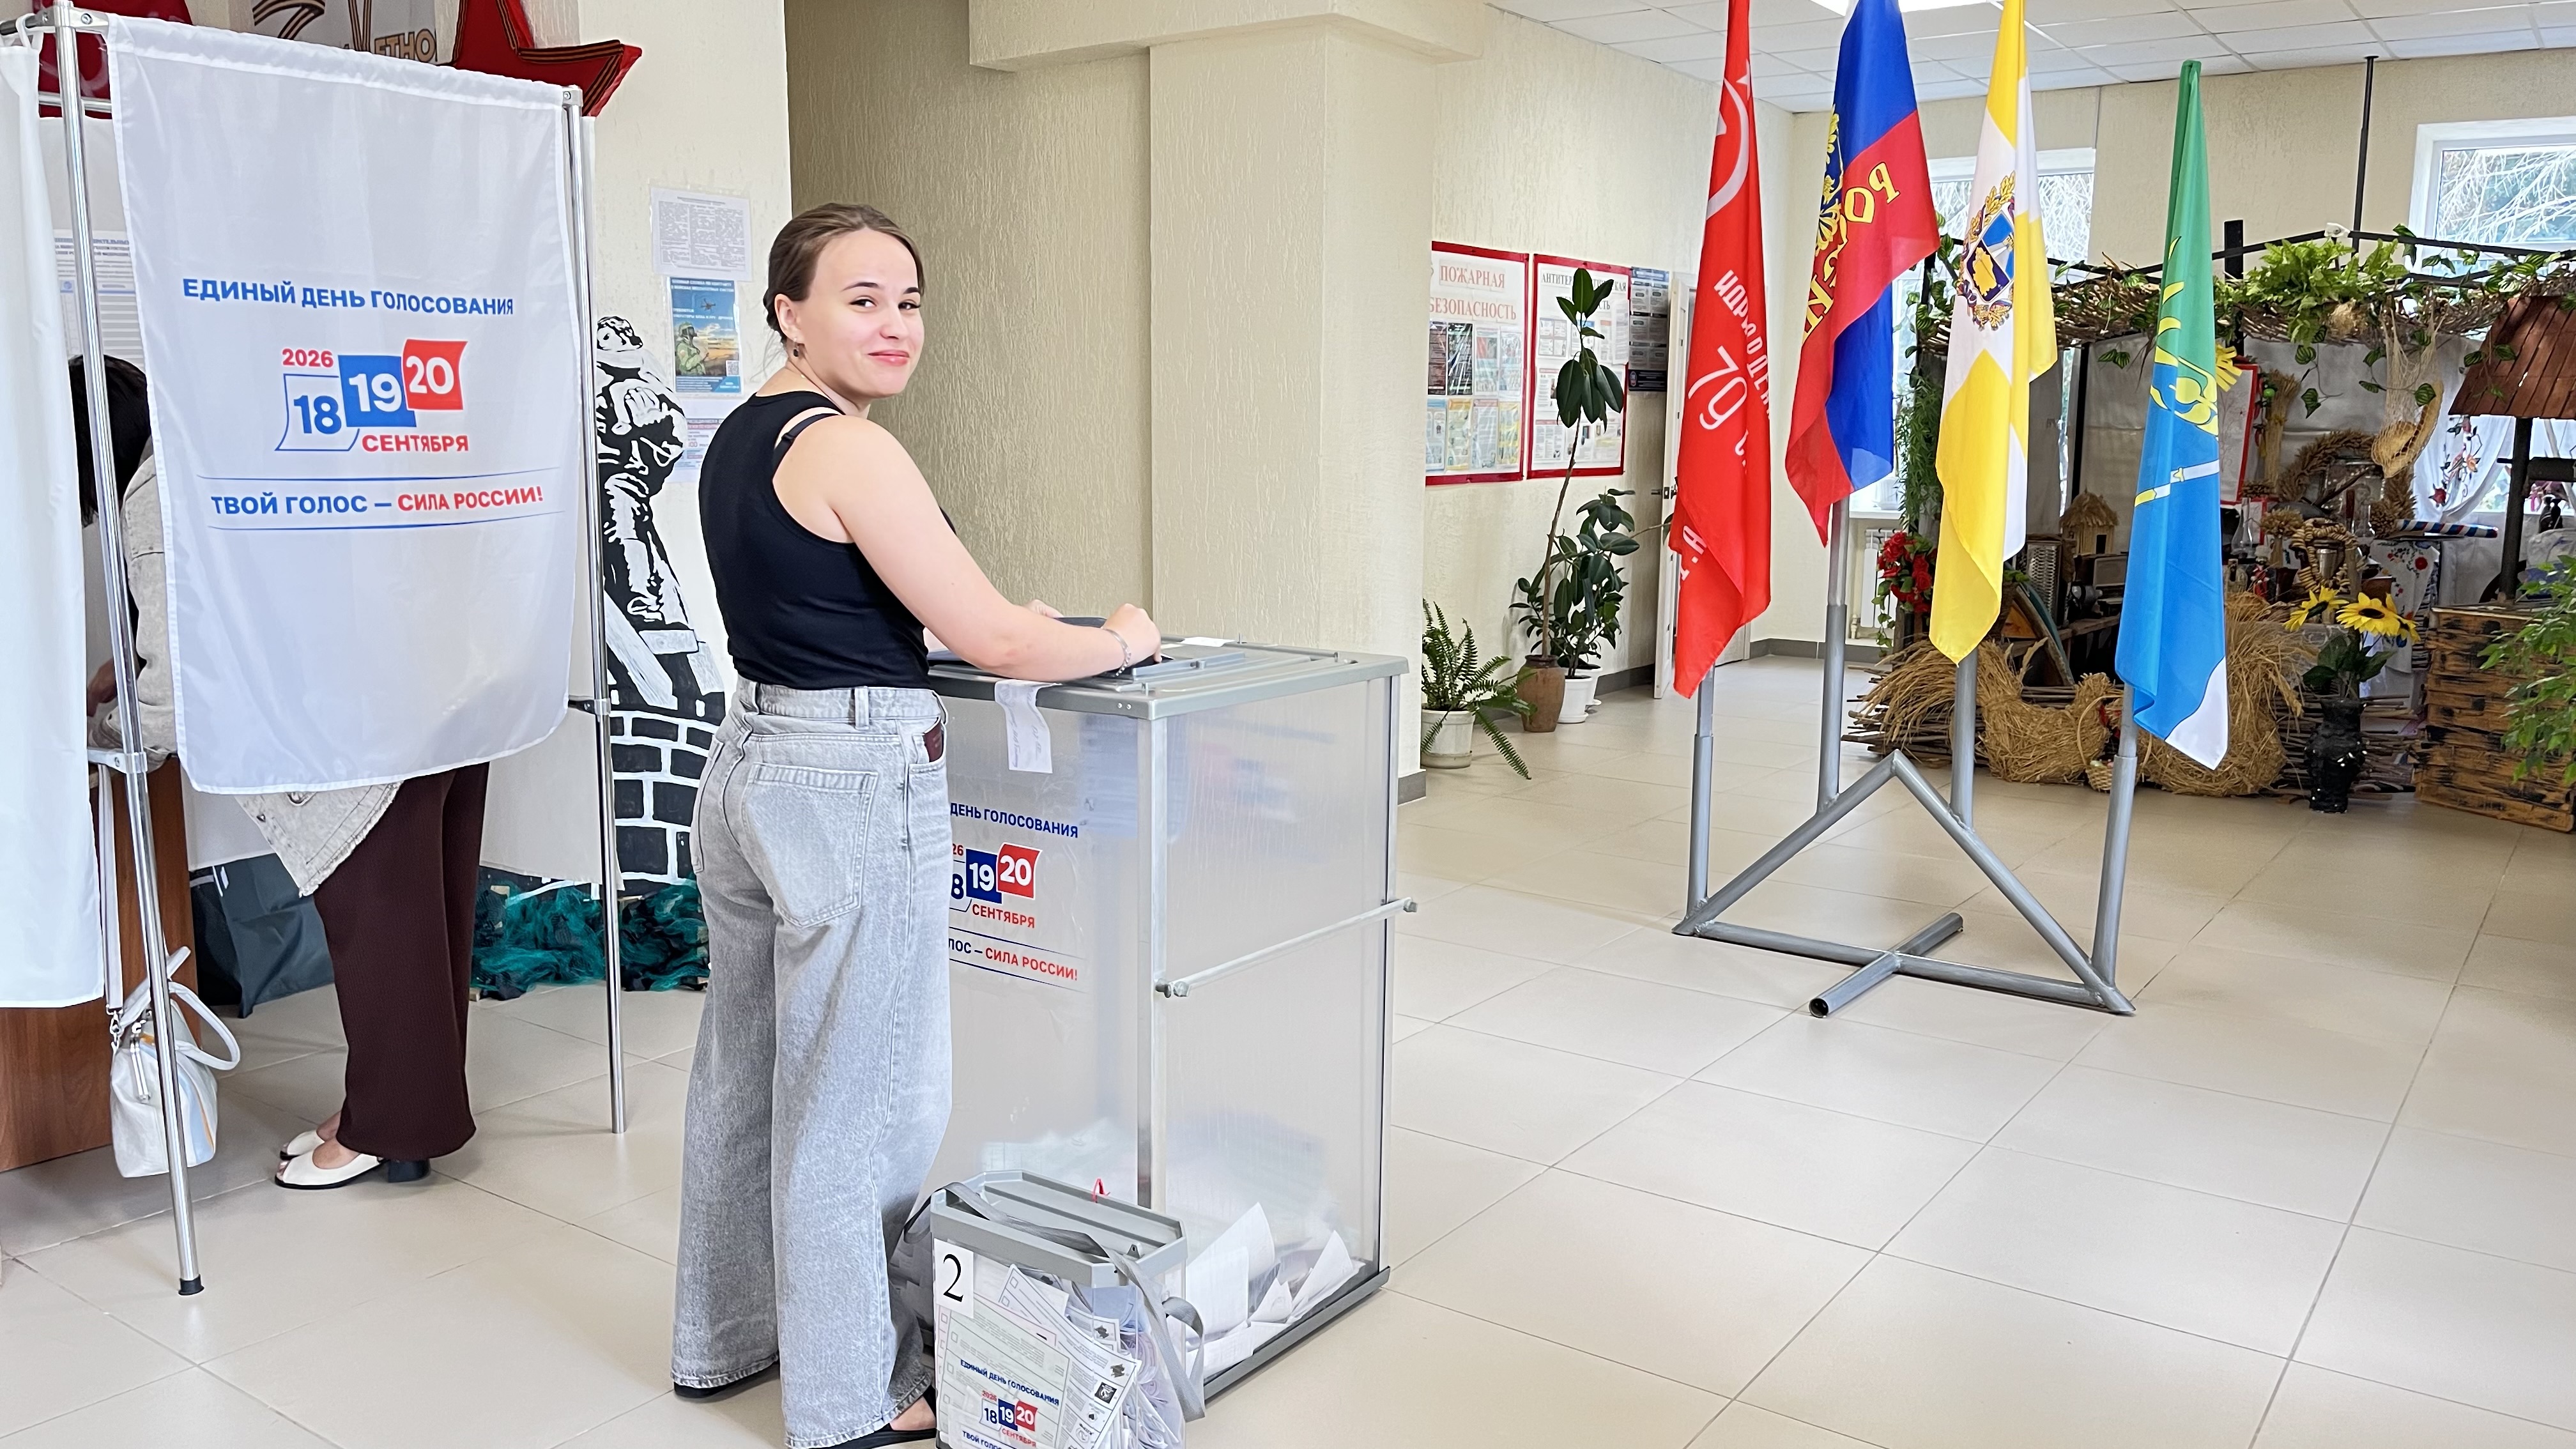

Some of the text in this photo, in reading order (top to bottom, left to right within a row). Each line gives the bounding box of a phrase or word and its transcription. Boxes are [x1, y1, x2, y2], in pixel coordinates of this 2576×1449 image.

[1441, 266, 1505, 288] ПОЖАРНАЯ
[183, 279, 513, 315] ЕДИНЫЙ ДЕНЬ ГОЛОСОВАНИЯ
[282, 348, 333, 367] 2026
[406, 356, 454, 394] 20
[1688, 345, 1748, 430] 79
[349, 373, 402, 412] 19
[294, 395, 341, 434] 18
[362, 434, 468, 452] СЕНТЯБРЯ
[211, 493, 277, 515] ТВОЙ
[287, 496, 367, 513] ГОЛОС
[398, 492, 449, 511] СИЛА
[454, 486, 544, 509] РОССИИ!
[950, 803, 1078, 838] ДЕНЬ ГОЛОСОВАНИЯ
[969, 862, 994, 891] 19
[1000, 855, 1032, 886] 20
[972, 903, 1035, 928] СЕНТЯБРЯ
[985, 947, 1018, 965] СИЛА
[1022, 956, 1077, 980] РОССИИ!
[943, 1254, 963, 1303] 2
[960, 1360, 1059, 1406] ЕДИНЫЙ ДЕНЬ ГОЛОСОВАНИЯ
[984, 1407, 997, 1424] 18
[1000, 1406, 1013, 1423] 19
[1016, 1406, 1034, 1425] 20
[1002, 1429, 1036, 1448] СЕНТЯБРЯ
